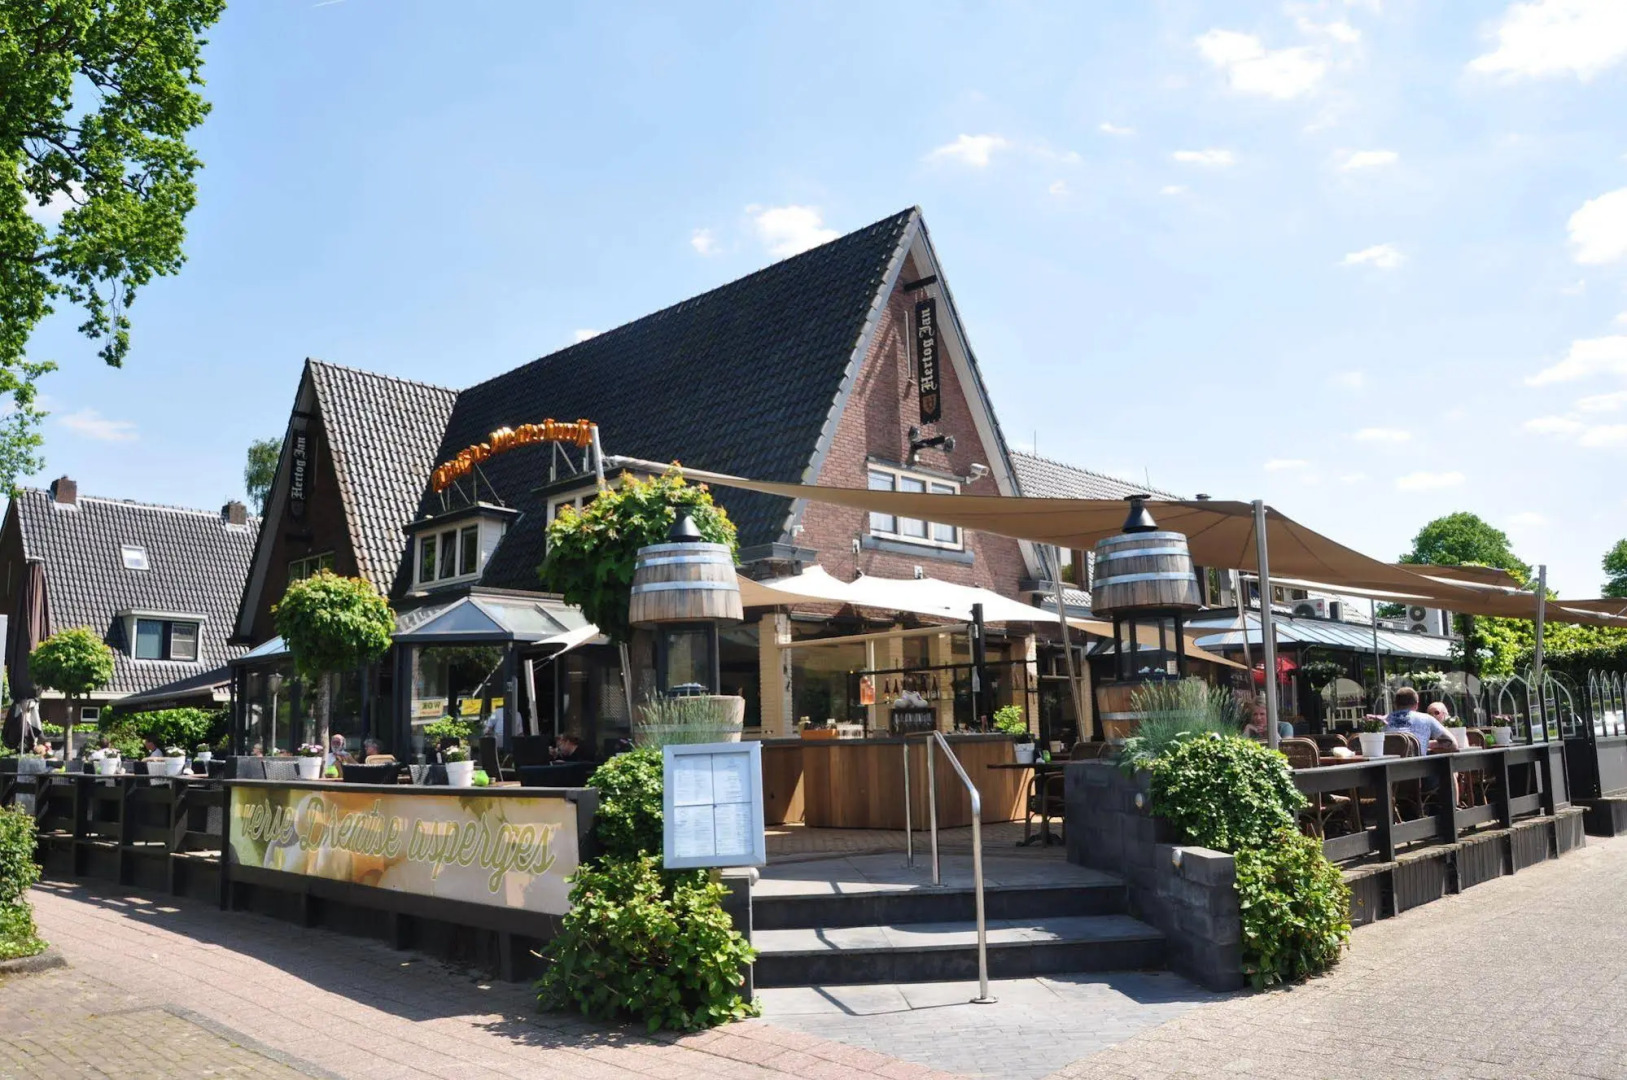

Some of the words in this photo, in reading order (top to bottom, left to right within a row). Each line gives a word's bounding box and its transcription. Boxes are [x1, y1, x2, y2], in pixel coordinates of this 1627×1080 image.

[919, 308, 934, 338] Jan
[921, 339, 937, 393] Hertog
[293, 437, 306, 459] Jan
[291, 459, 306, 499] Hertog
[241, 798, 296, 844] verse
[299, 796, 402, 859] Drentse
[407, 812, 556, 893] asperges
